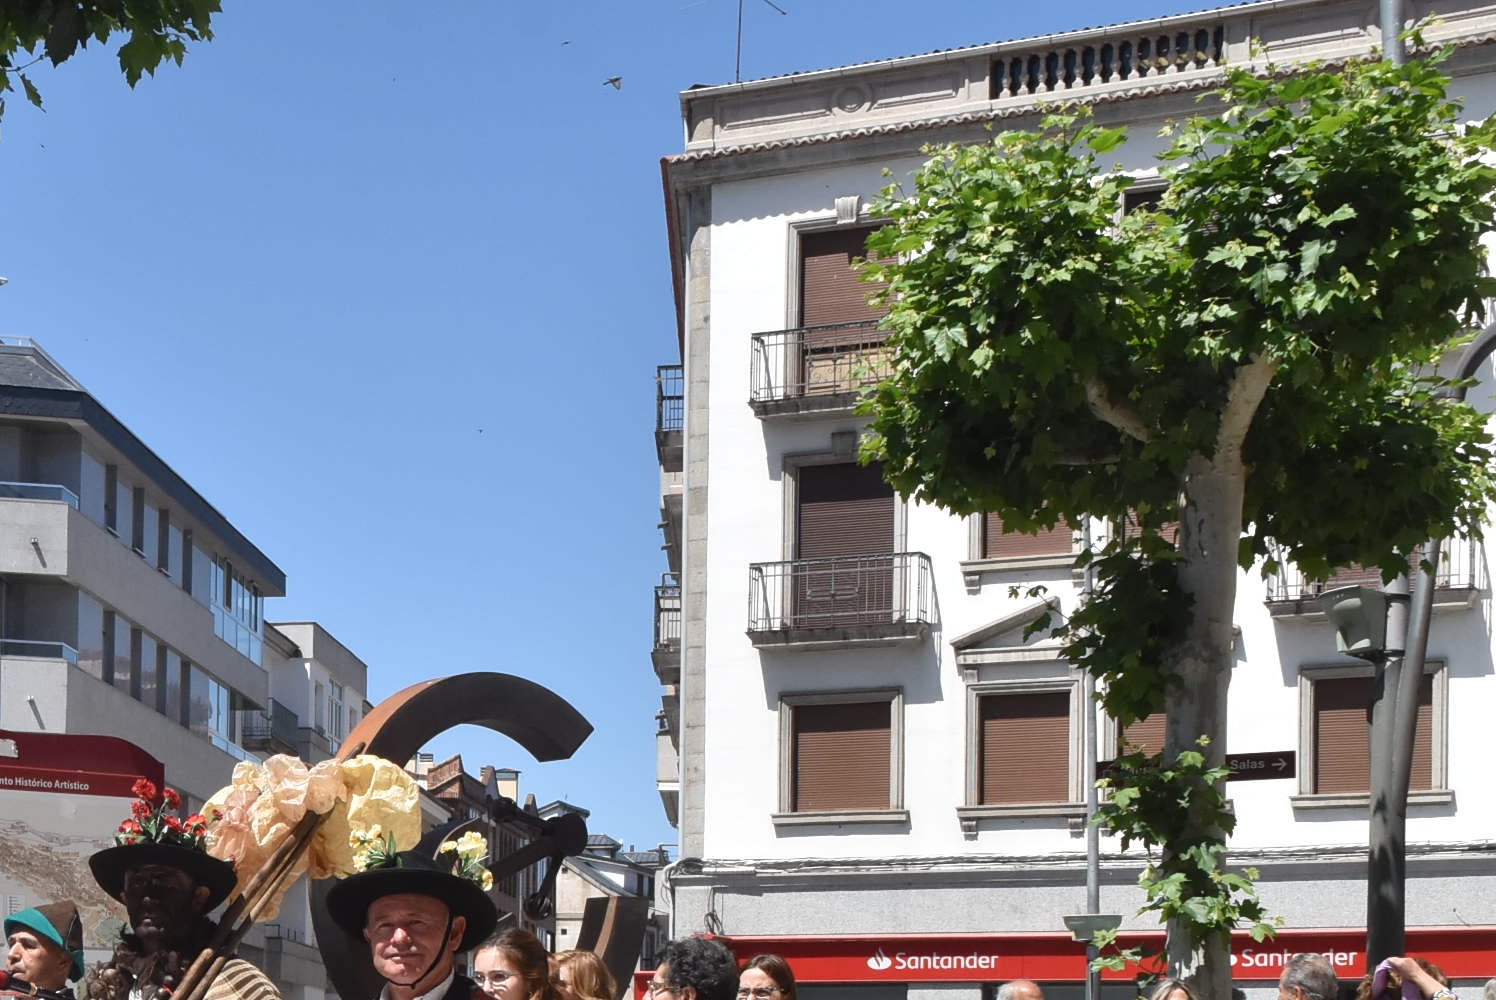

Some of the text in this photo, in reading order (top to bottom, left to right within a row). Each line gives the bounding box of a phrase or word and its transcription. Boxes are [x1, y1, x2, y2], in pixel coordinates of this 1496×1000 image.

[1229, 758, 1265, 770] Salas
[15, 777, 53, 788] Histórico
[54, 779, 90, 791] Artístico
[895, 952, 999, 970] Santander
